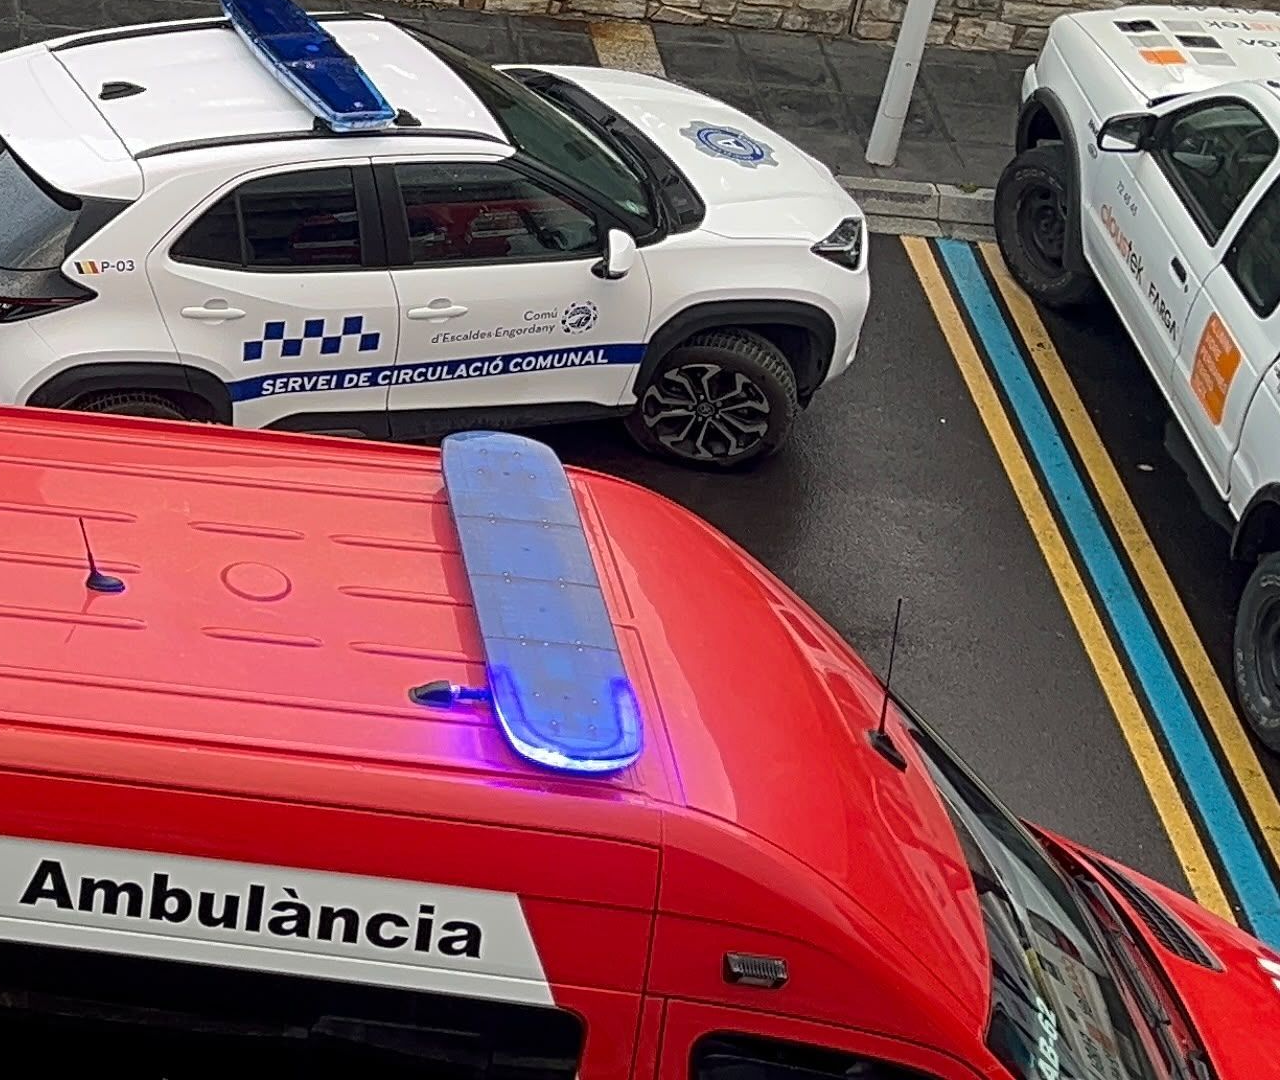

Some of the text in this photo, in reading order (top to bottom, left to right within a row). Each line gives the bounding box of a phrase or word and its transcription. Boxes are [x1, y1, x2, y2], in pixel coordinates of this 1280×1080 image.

[101, 260, 136, 273] P-03
[523, 307, 559, 323] Comú
[261, 349, 609, 396] SERVEI DE CIRCULACIÓ COMUNAL
[19, 858, 484, 960] Ambulància
